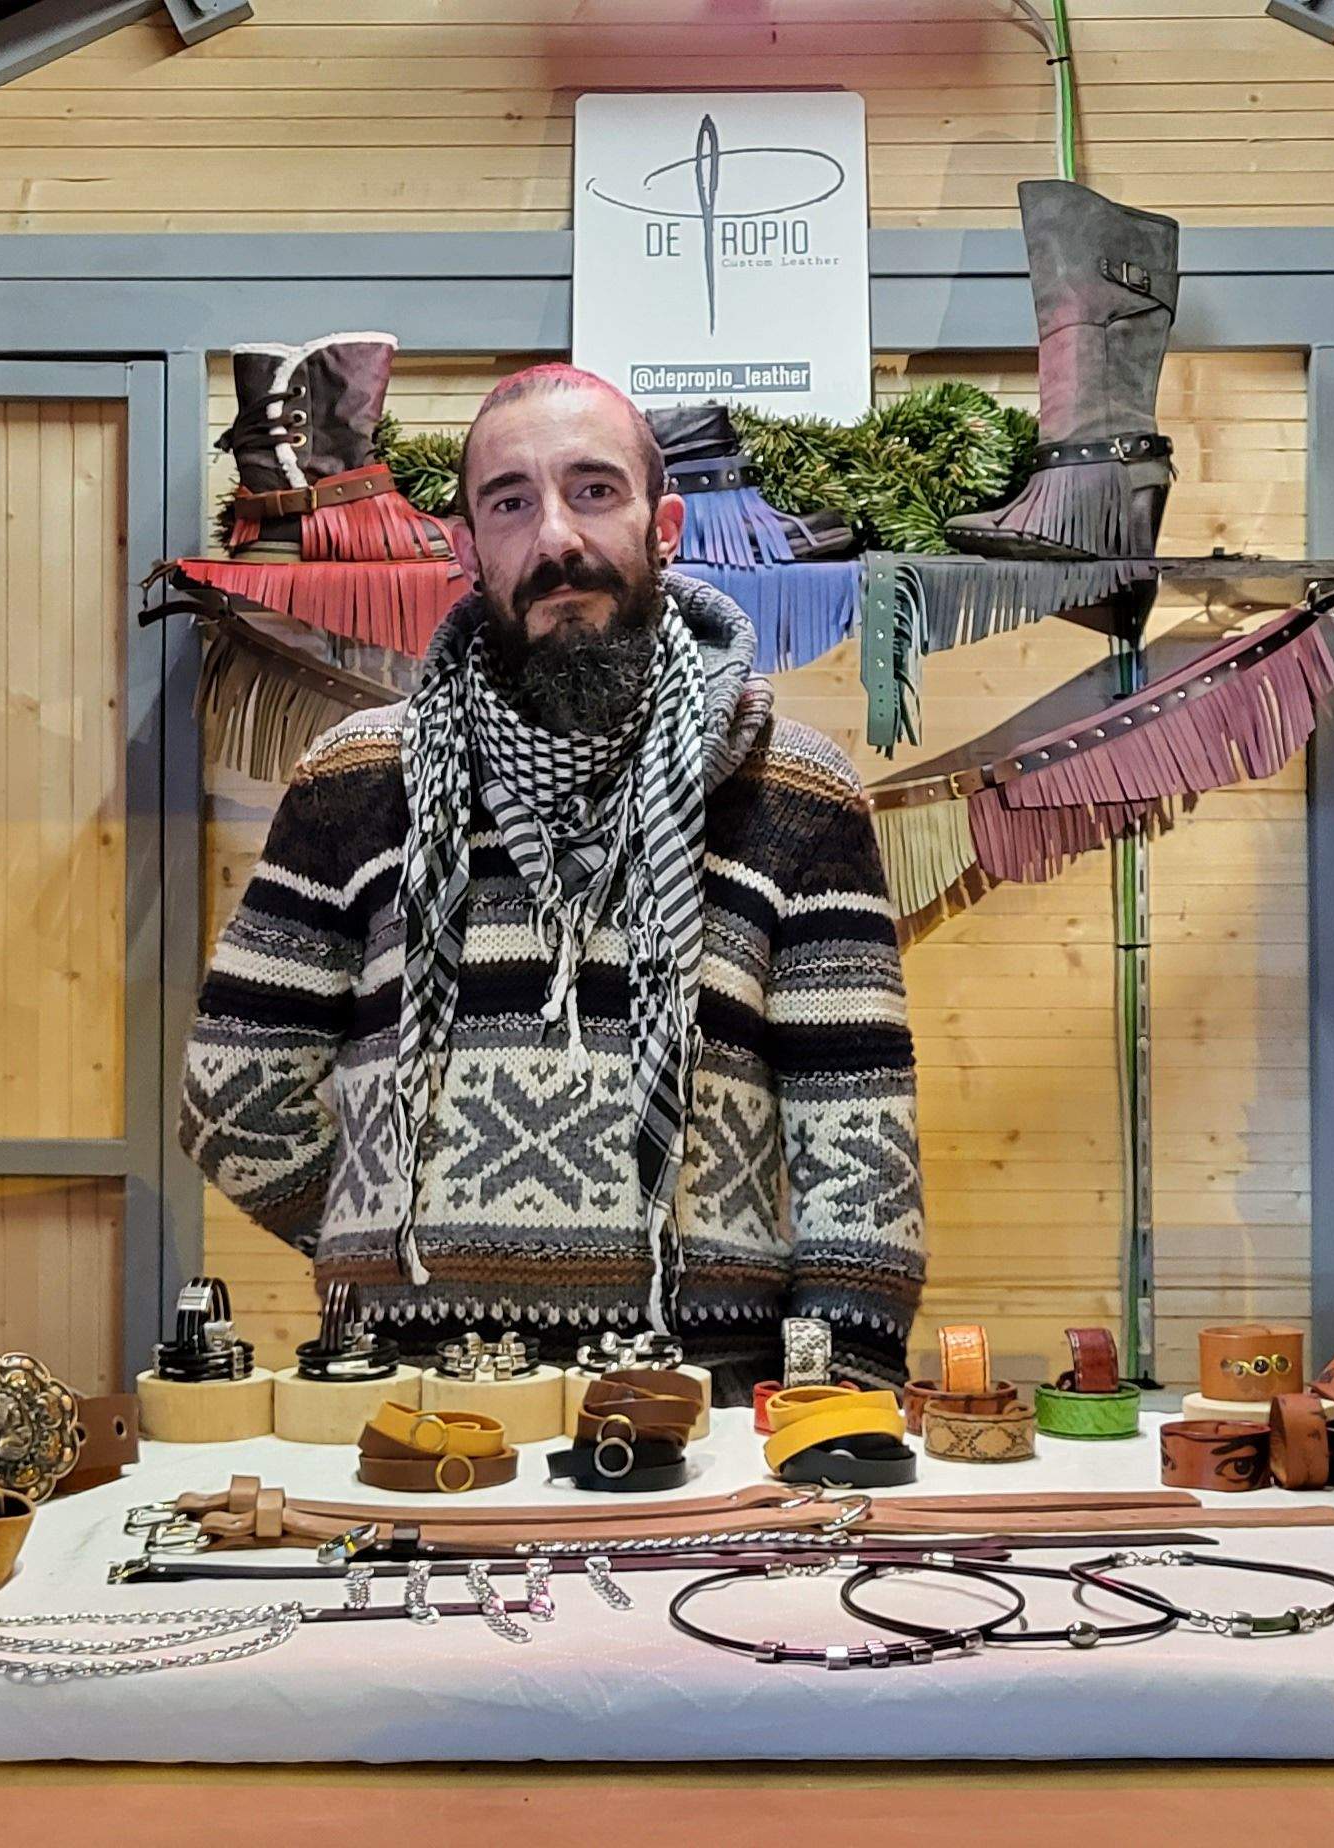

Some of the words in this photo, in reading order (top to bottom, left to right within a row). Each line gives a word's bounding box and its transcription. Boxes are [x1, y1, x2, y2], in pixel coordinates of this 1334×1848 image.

[646, 222, 681, 257] DE
[721, 258, 774, 269] Custom
[780, 256, 840, 267] Leather
[631, 366, 809, 394] @depropio_leather
